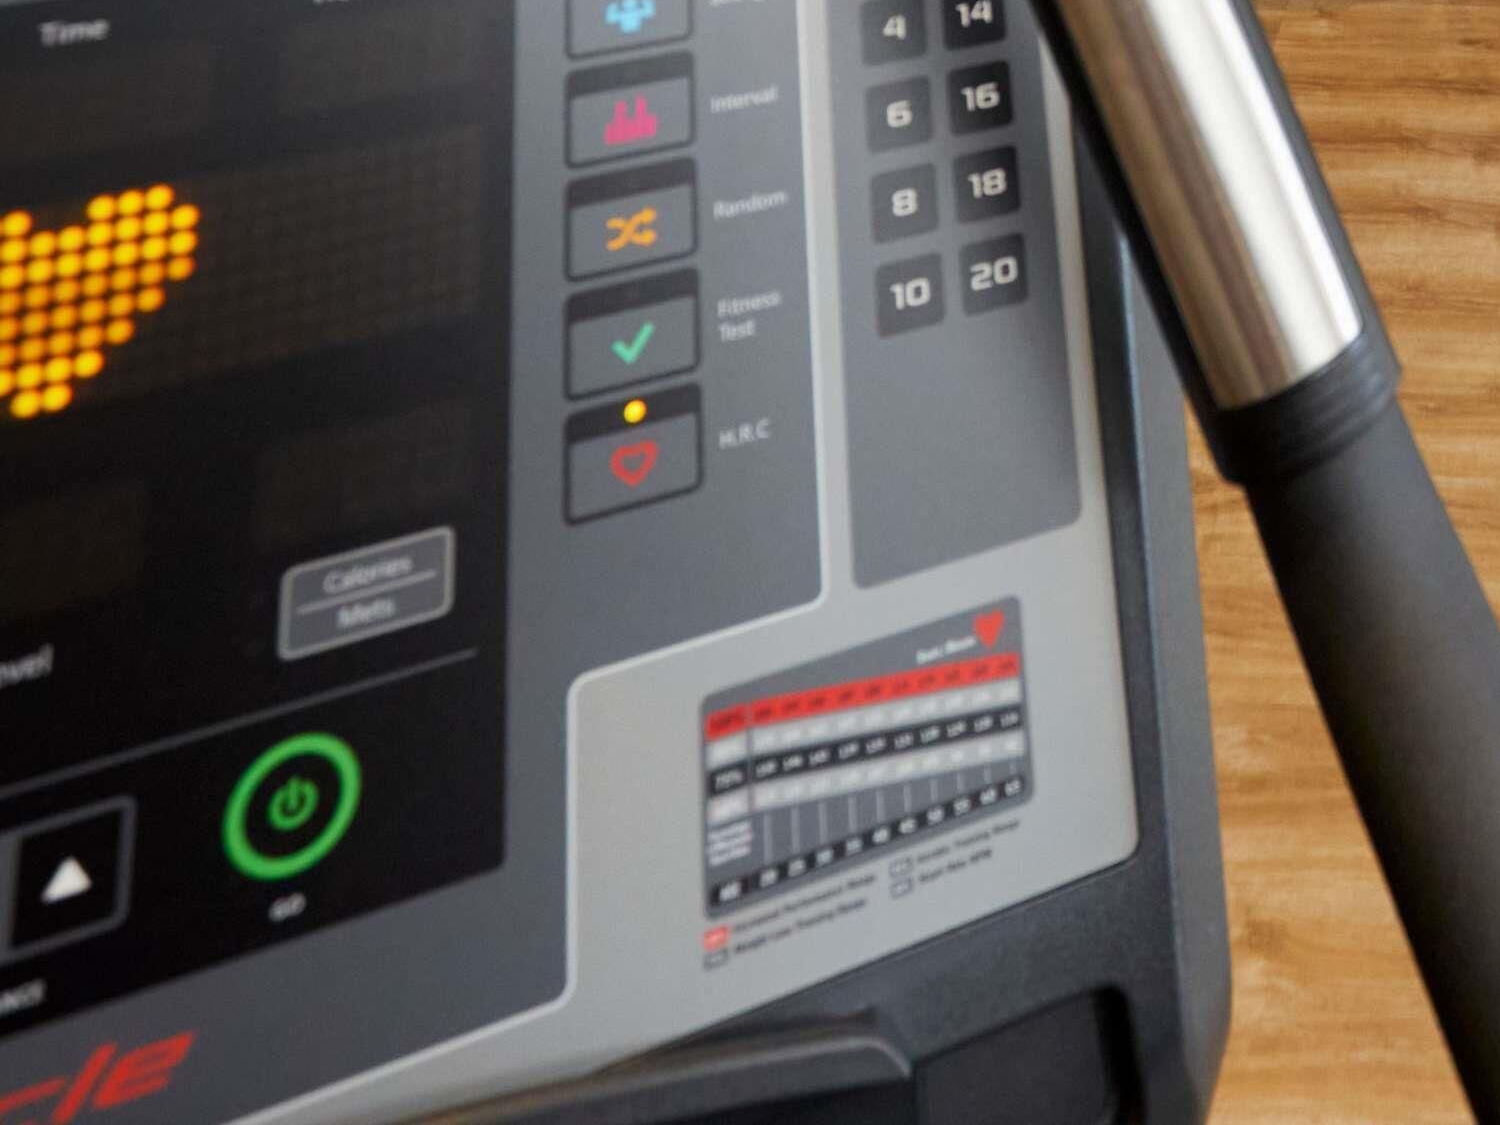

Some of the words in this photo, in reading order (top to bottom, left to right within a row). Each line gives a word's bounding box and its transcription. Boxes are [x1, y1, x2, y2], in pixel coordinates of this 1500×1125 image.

[883, 15, 907, 40] 4
[955, 0, 993, 27] 14
[39, 19, 109, 48] Time
[710, 84, 780, 113] Interval
[961, 82, 1000, 111] 16
[887, 100, 912, 128] 6
[967, 168, 1007, 199] 18
[713, 191, 788, 219] Random
[891, 187, 917, 217] 8
[970, 256, 1019, 291] 20
[717, 292, 781, 316] Fitness
[889, 277, 931, 310] 10
[719, 320, 756, 343] Test
